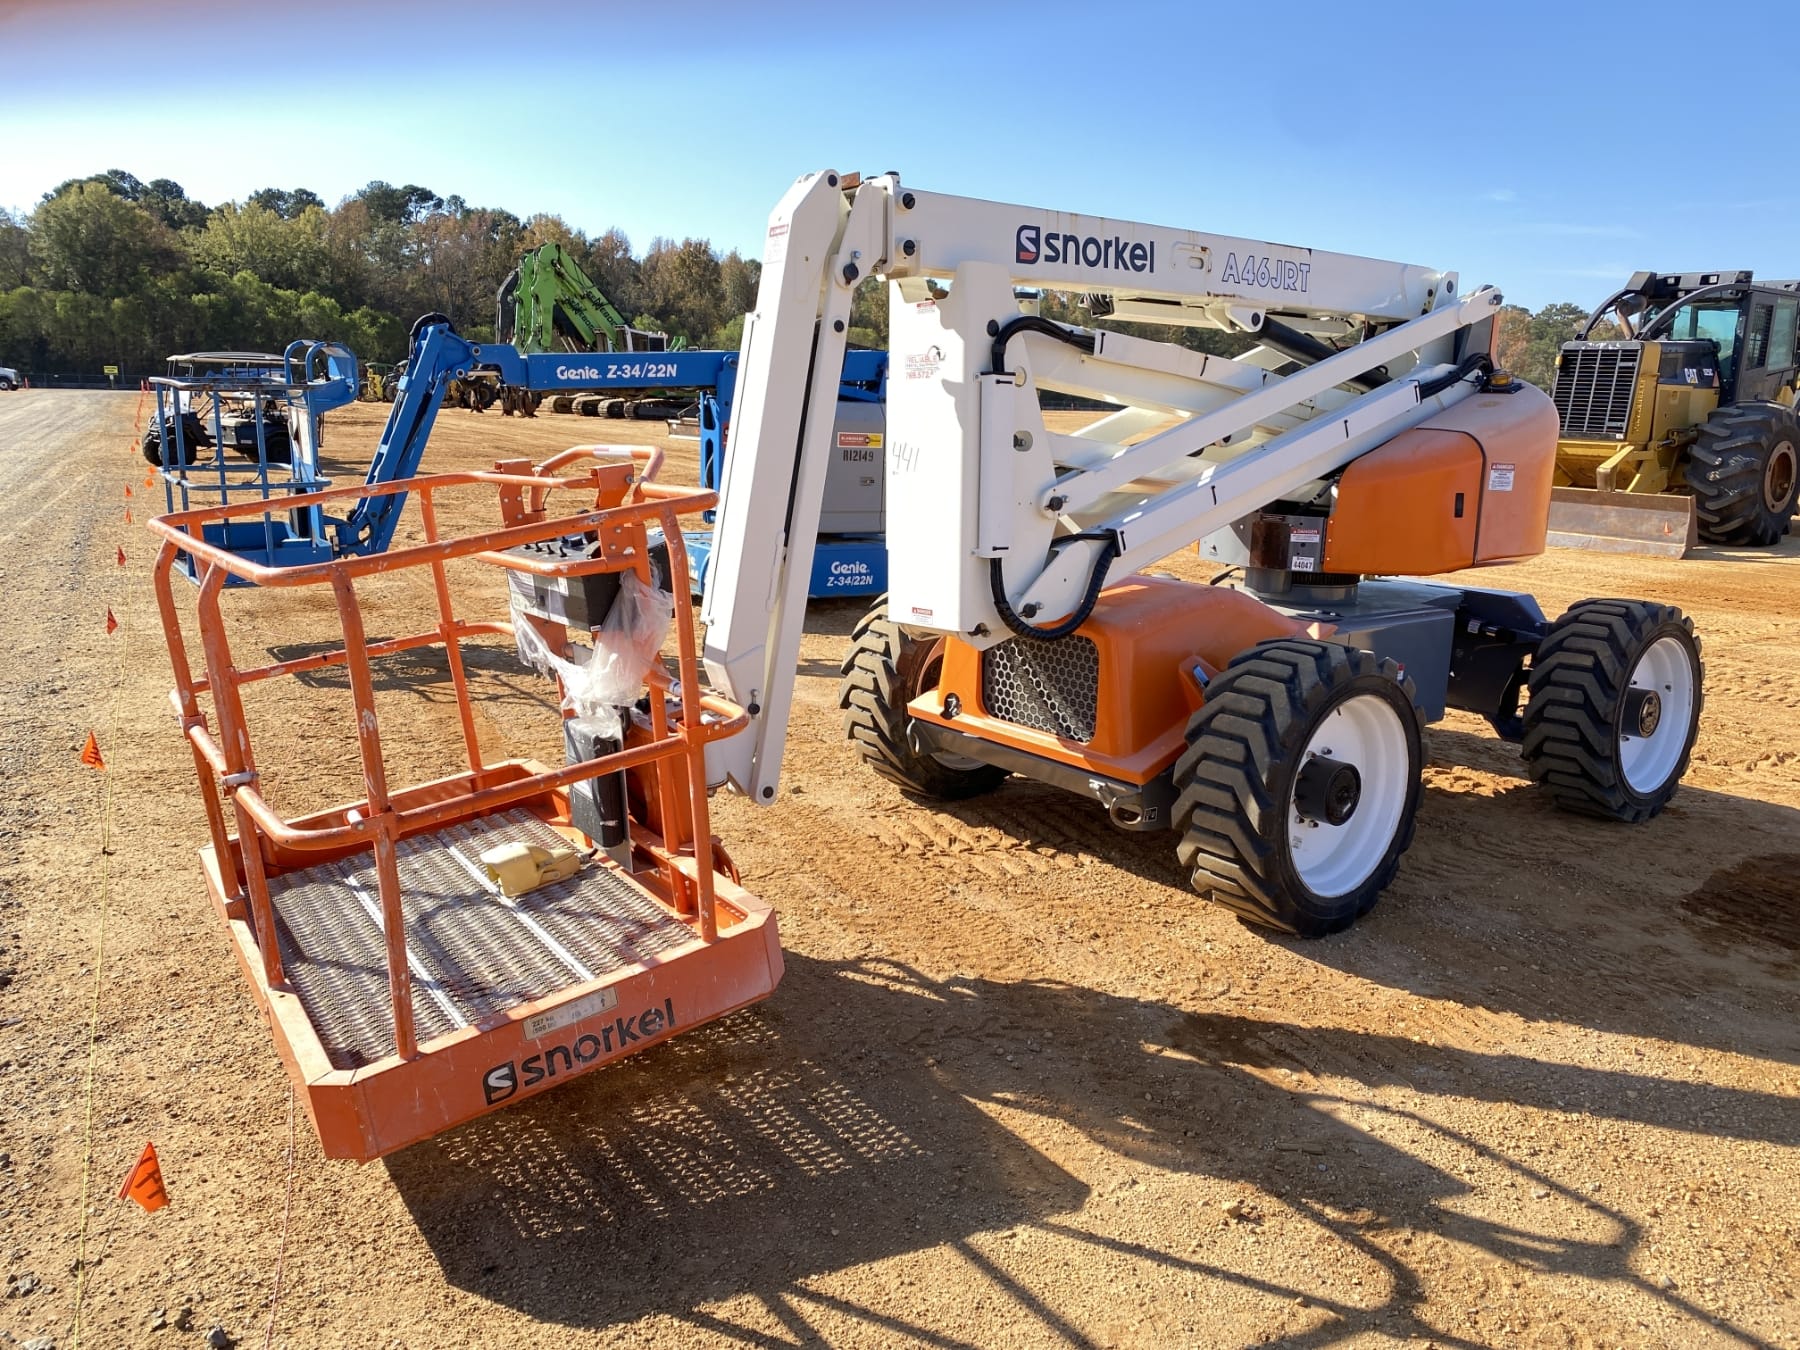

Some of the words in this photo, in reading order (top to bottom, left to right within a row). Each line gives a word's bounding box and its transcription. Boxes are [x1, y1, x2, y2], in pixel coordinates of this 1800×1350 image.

[1044, 232, 1155, 273] snorkel
[1222, 252, 1311, 292] A46JRT
[556, 365, 599, 379] Genie
[606, 363, 678, 379] Z-34/22N
[1684, 367, 1699, 384] CAT
[831, 561, 868, 575] Genie
[827, 575, 874, 587] Z-34/22N
[521, 997, 676, 1087] snorkel
